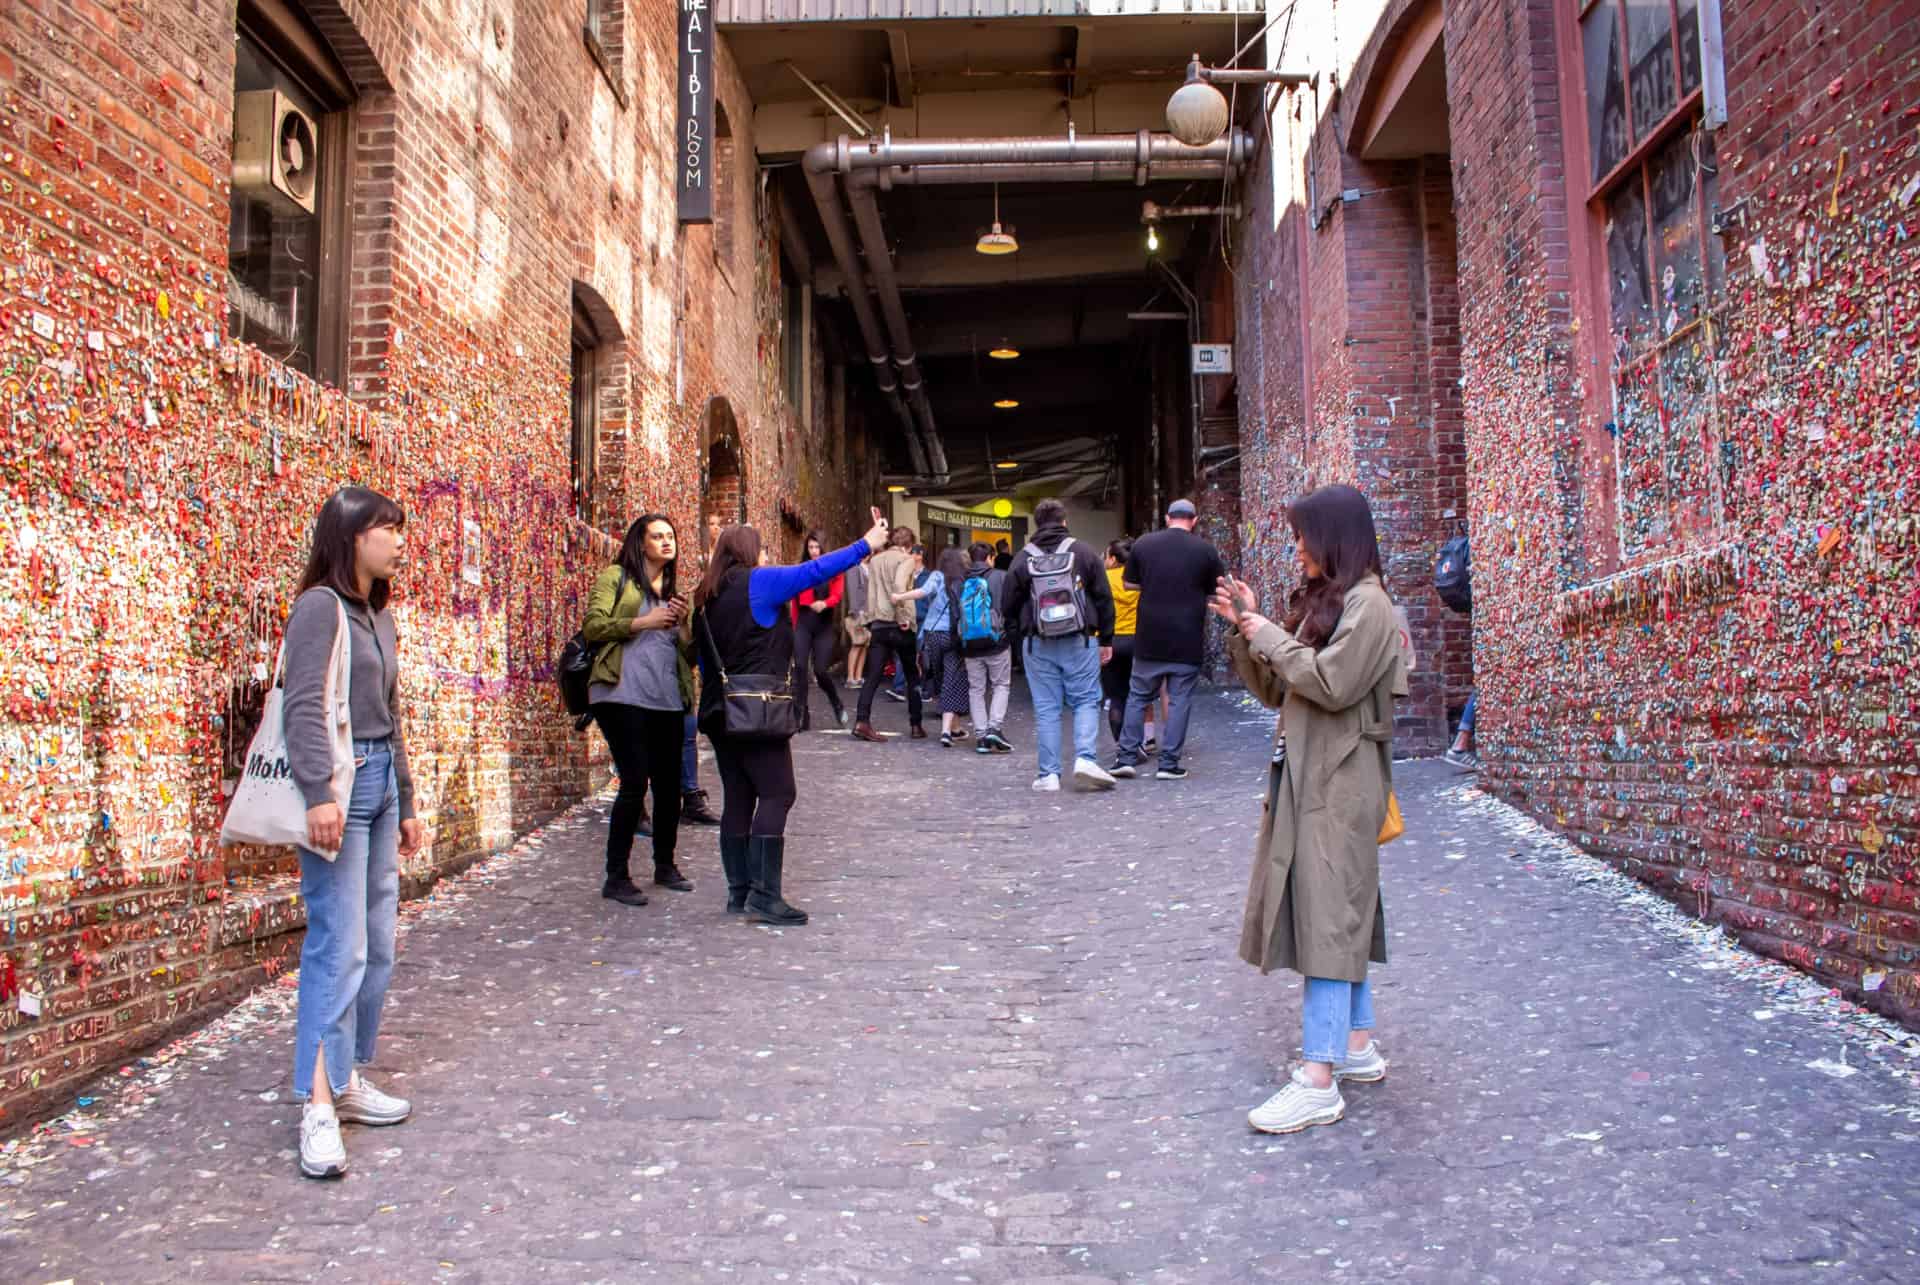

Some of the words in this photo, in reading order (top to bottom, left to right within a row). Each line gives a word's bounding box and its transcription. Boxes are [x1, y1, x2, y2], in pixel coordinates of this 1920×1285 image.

[687, 11, 702, 116] ALIBI
[686, 118, 702, 188] ROOM
[971, 516, 1012, 529] ESPRESSO
